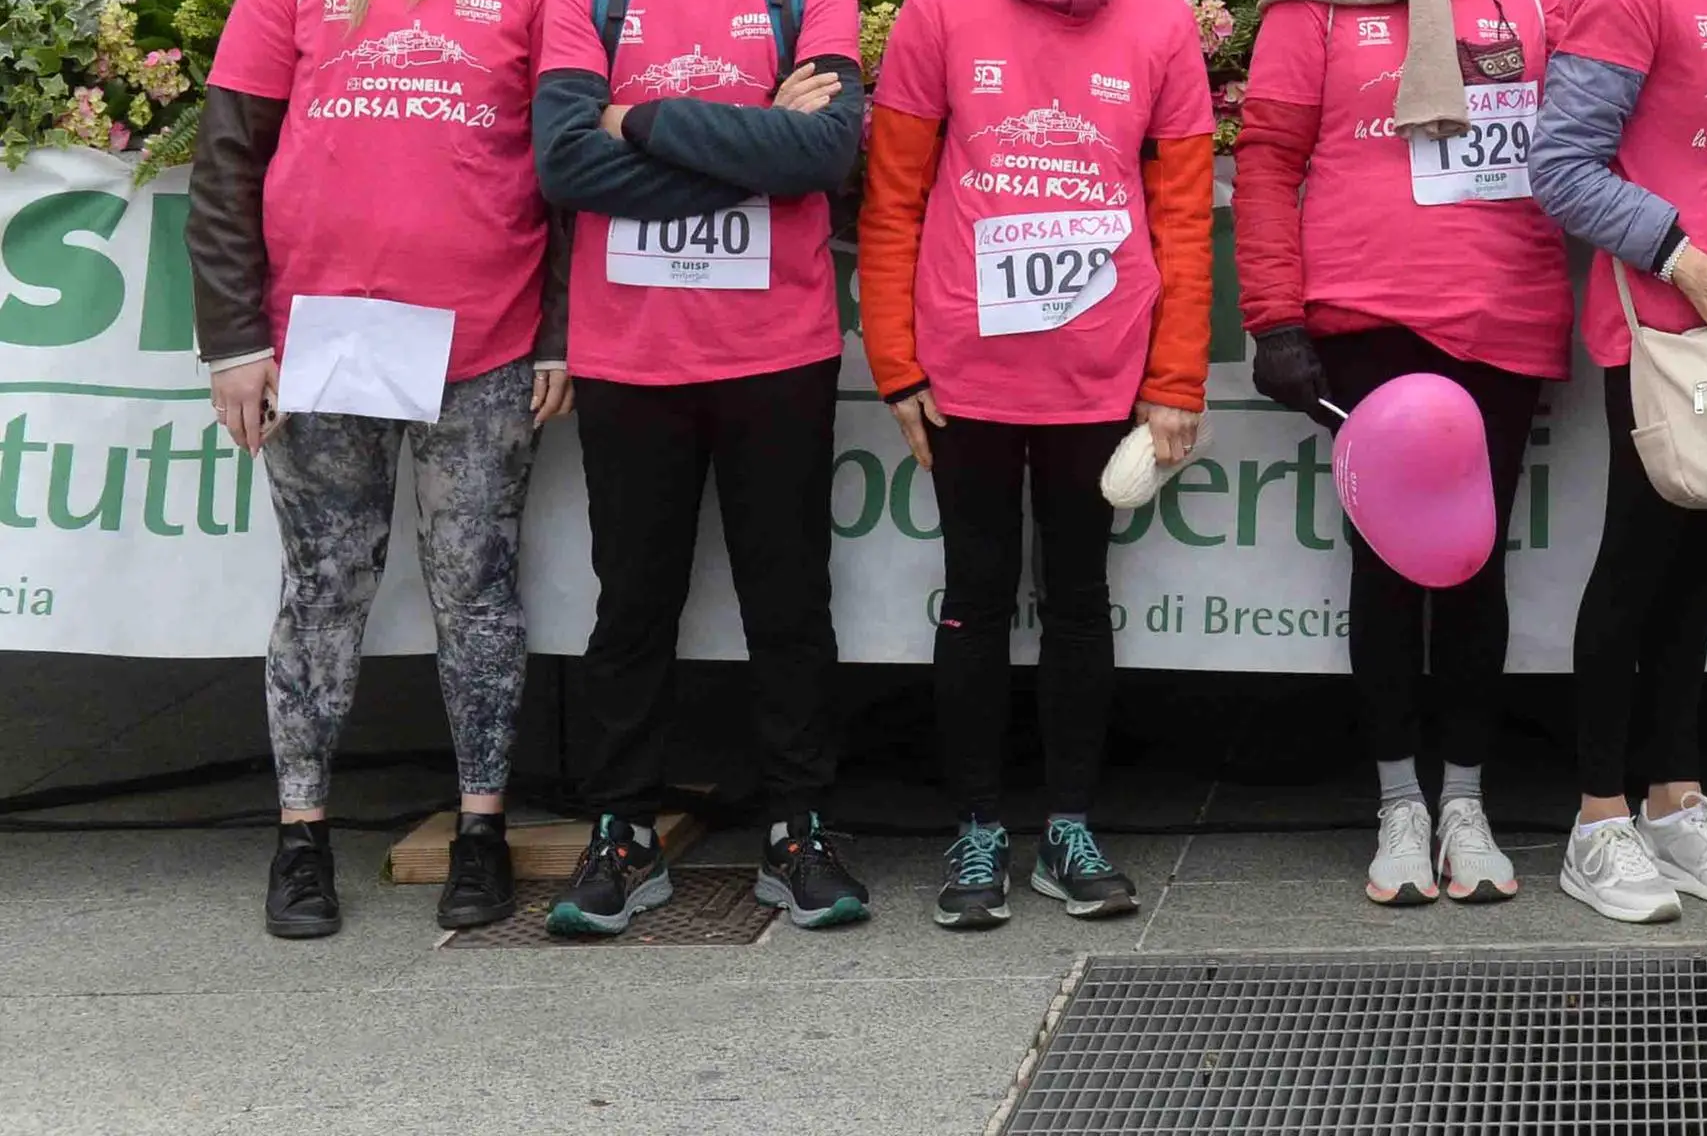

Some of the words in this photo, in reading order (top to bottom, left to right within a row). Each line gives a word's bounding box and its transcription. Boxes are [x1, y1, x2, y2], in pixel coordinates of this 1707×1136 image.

[362, 76, 463, 95] COTONELLA
[1102, 76, 1131, 92] UISP
[1496, 87, 1537, 110] ROSA
[323, 96, 400, 119] CORSA
[405, 96, 467, 124] ROSA
[466, 103, 498, 128] 26
[1429, 119, 1530, 171] 1329
[1004, 155, 1100, 176] COTONELLA
[1484, 172, 1508, 183] UISP
[974, 172, 1040, 198] CORSA
[1045, 176, 1106, 204] ROSA
[637, 210, 751, 255] 1040
[992, 219, 1065, 244] CORSA
[1069, 214, 1126, 237] ROSA
[682, 261, 711, 270] UISP
[1145, 594, 1186, 634] di
[1204, 597, 1351, 638] Brescia
